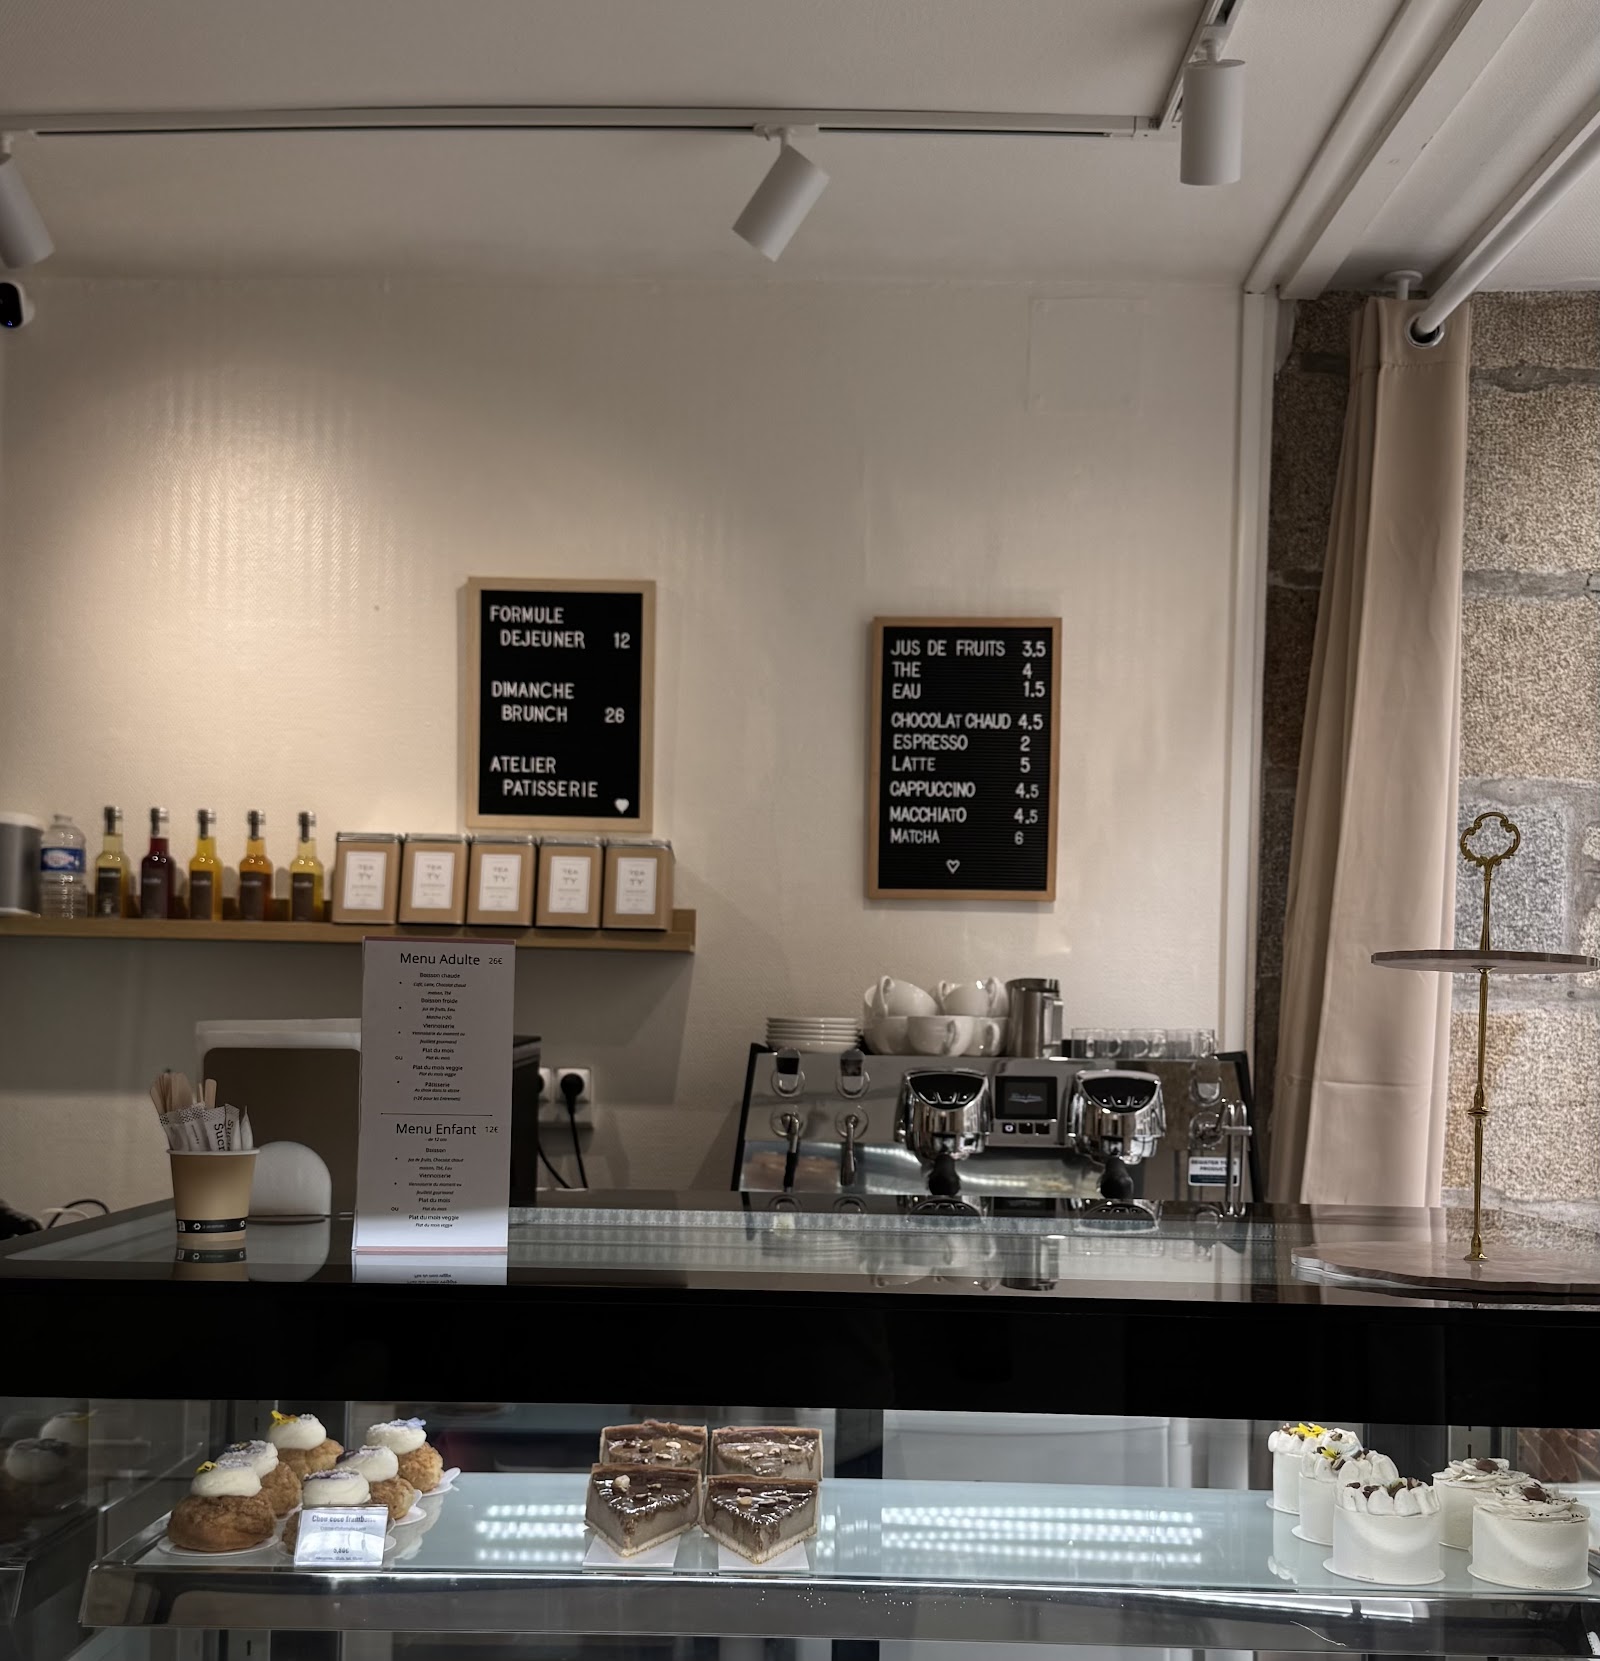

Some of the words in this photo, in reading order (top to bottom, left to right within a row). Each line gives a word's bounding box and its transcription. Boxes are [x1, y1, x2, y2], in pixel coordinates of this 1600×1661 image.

[490, 605, 564, 624] FORMULE
[500, 630, 585, 649] DEJEUNER
[614, 632, 631, 649] 12
[891, 640, 920, 656] JUS
[928, 640, 946, 656] DE
[956, 640, 1005, 657] FRUITS
[1022, 641, 1046, 657] 3.5
[892, 662, 921, 678] THE
[1022, 663, 1032, 679] 4
[491, 681, 575, 699] DIMANCHE
[892, 684, 921, 699] EAU
[1024, 681, 1045, 698] 1.5
[502, 705, 568, 723] BRUNCH
[605, 708, 625, 724] 26
[891, 712, 962, 729] CHOCOLAT
[964, 713, 1011, 729] CHAUD
[1018, 714, 1043, 730] 4.5
[893, 734, 968, 751] ESPRESSO
[1020, 736, 1030, 752] 2
[490, 756, 556, 774] ATELIER
[892, 756, 936, 772] LATTE
[1020, 757, 1030, 773] 5
[502, 779, 598, 798] PATISSERIE
[890, 781, 976, 798] CAPPUCCINO
[1016, 782, 1039, 799] 4.5
[890, 806, 967, 823] MACCHIATO
[1014, 808, 1038, 824] 4.5
[890, 828, 940, 844] MATCHA
[1014, 831, 1024, 844] 6
[400, 953, 436, 964] Menu
[439, 954, 480, 966] Adulte
[396, 1123, 432, 1134] Menu
[436, 1124, 476, 1135] Enfant
[485, 1126, 498, 1134] 12€
[312, 1514, 328, 1523] Chou
